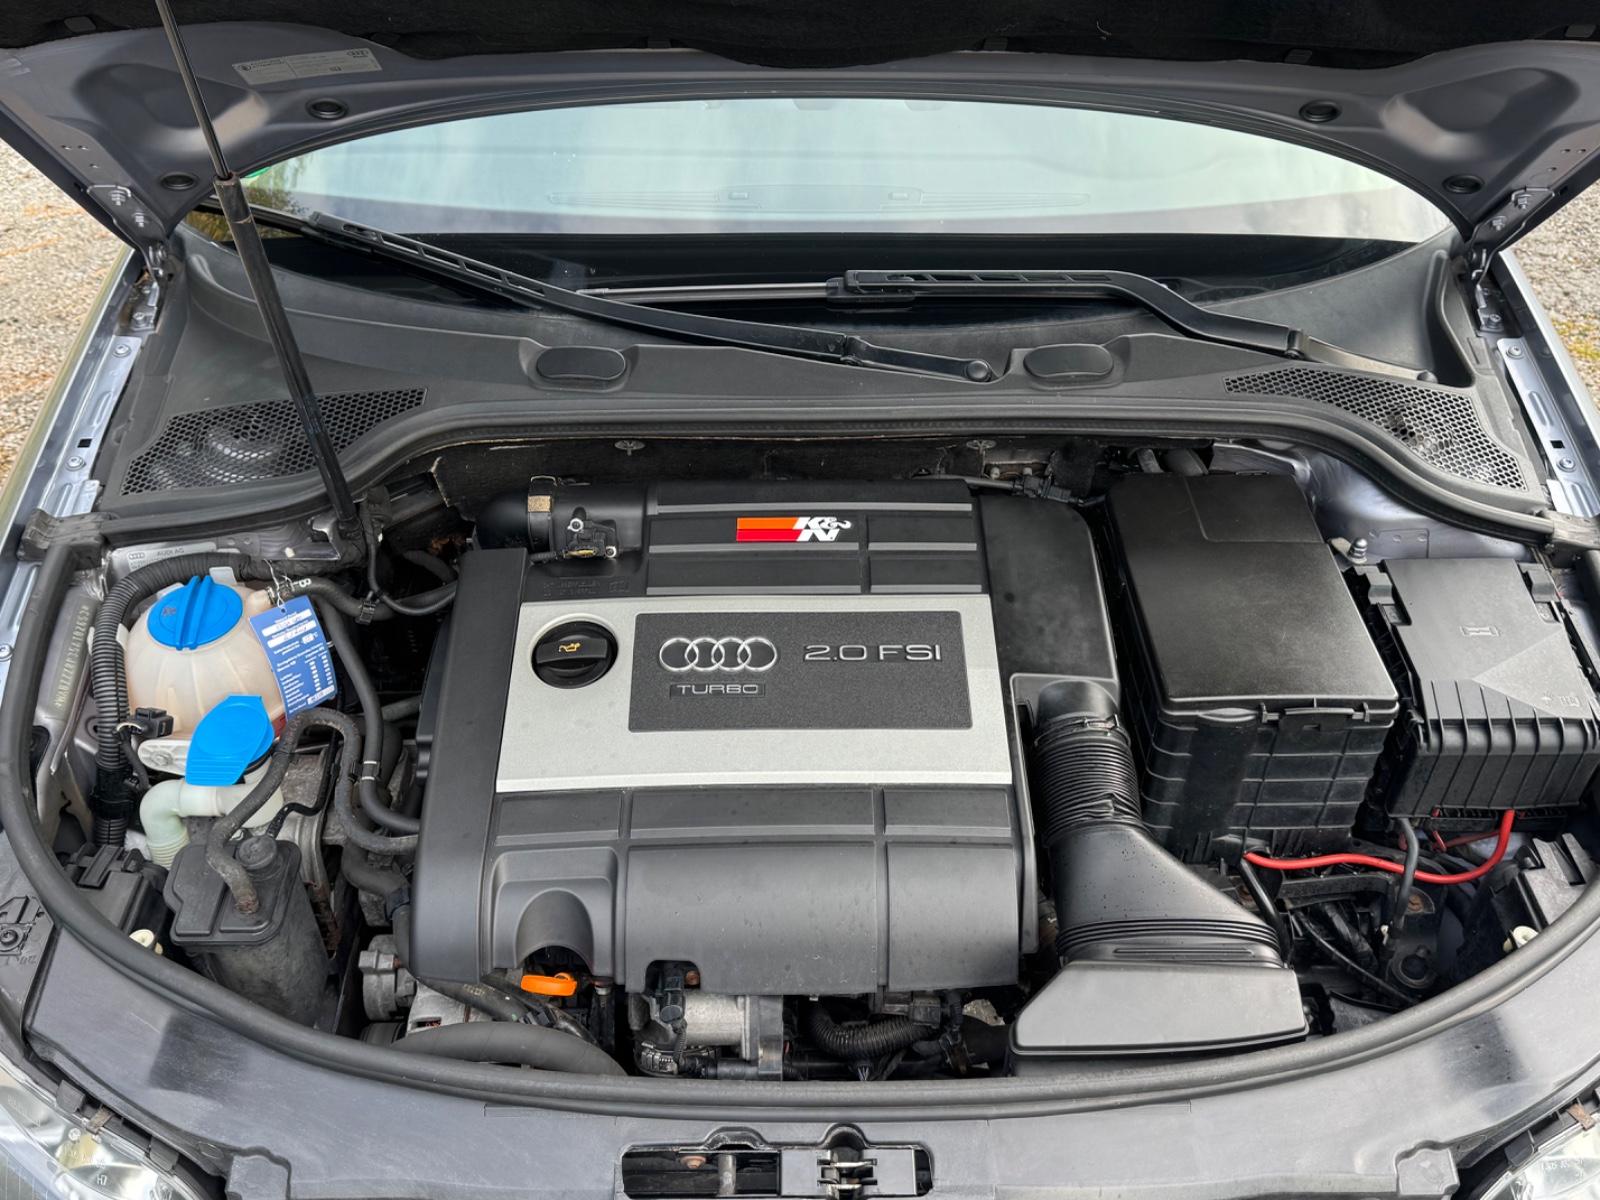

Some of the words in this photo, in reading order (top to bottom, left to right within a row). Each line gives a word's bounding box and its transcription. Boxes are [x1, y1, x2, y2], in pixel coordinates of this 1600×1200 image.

[793, 516, 852, 542] K&N
[804, 644, 867, 661] 2.0
[878, 644, 941, 661] FSI
[676, 684, 759, 695] TURBO
